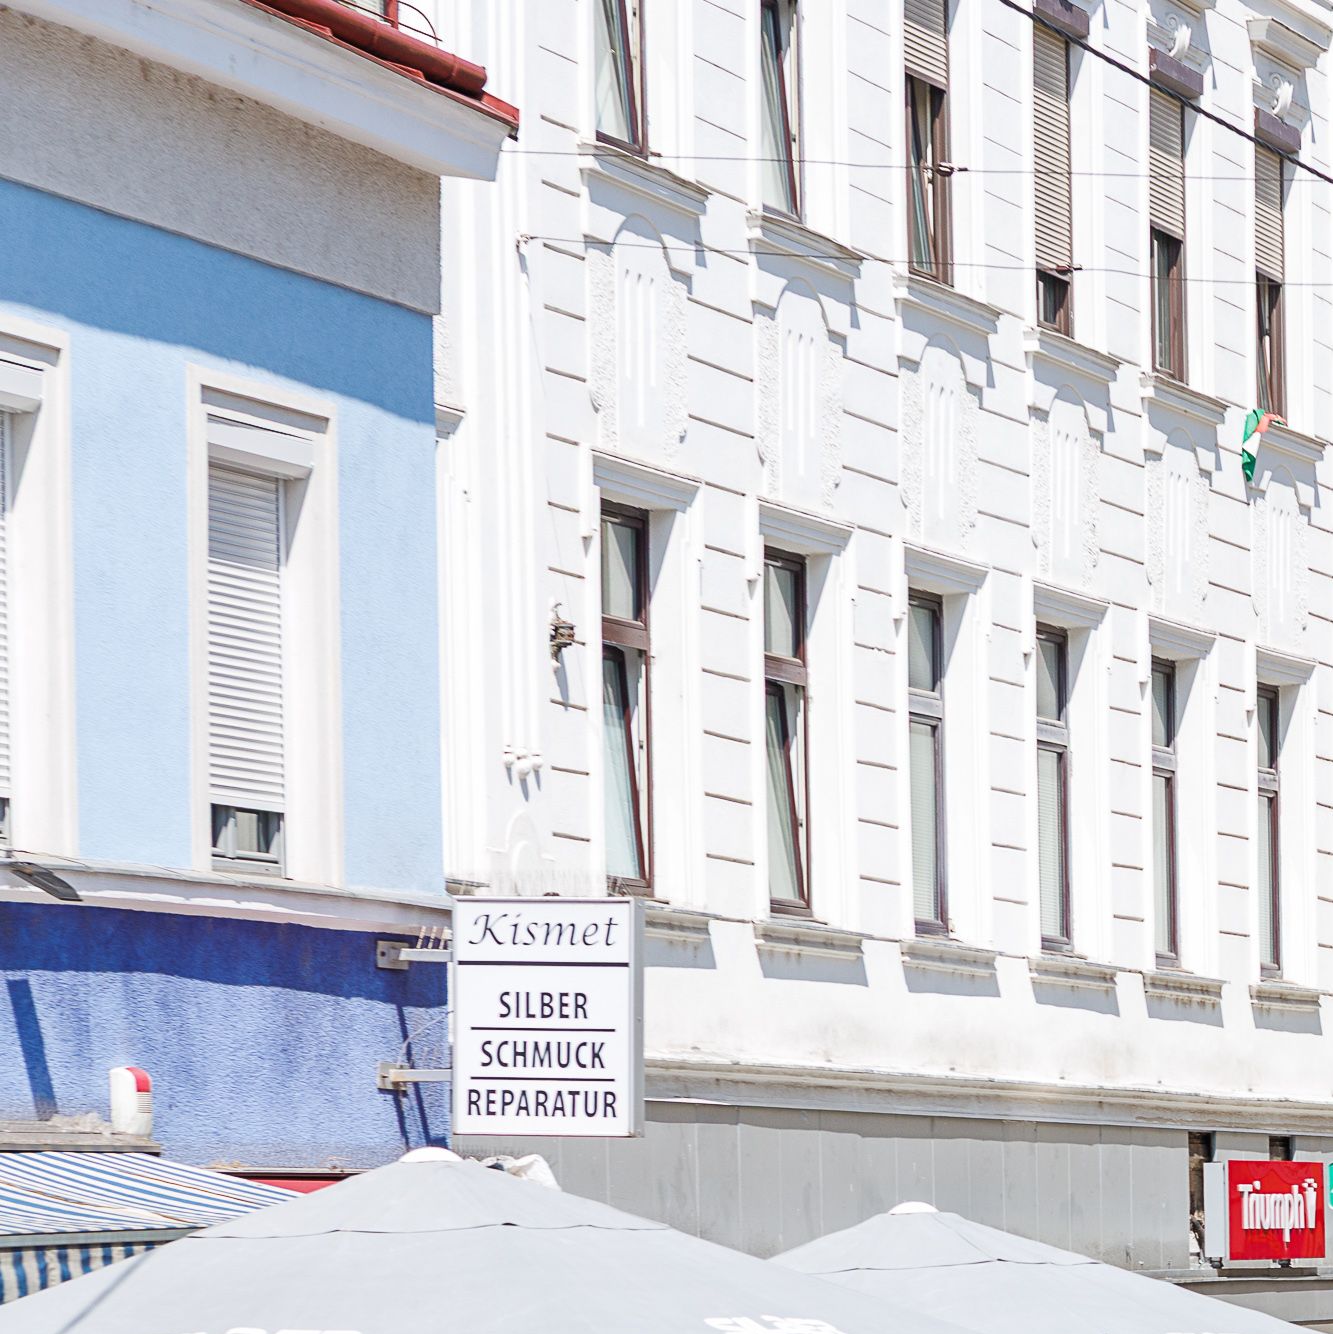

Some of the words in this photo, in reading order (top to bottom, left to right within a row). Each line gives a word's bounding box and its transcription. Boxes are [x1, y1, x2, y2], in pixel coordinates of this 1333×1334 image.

[469, 913, 619, 946] Kismet
[499, 991, 588, 1019] SILBER
[481, 1040, 606, 1069] SCHMUCK
[467, 1089, 617, 1118] REPARATUR
[1236, 1180, 1304, 1243] Triumph
